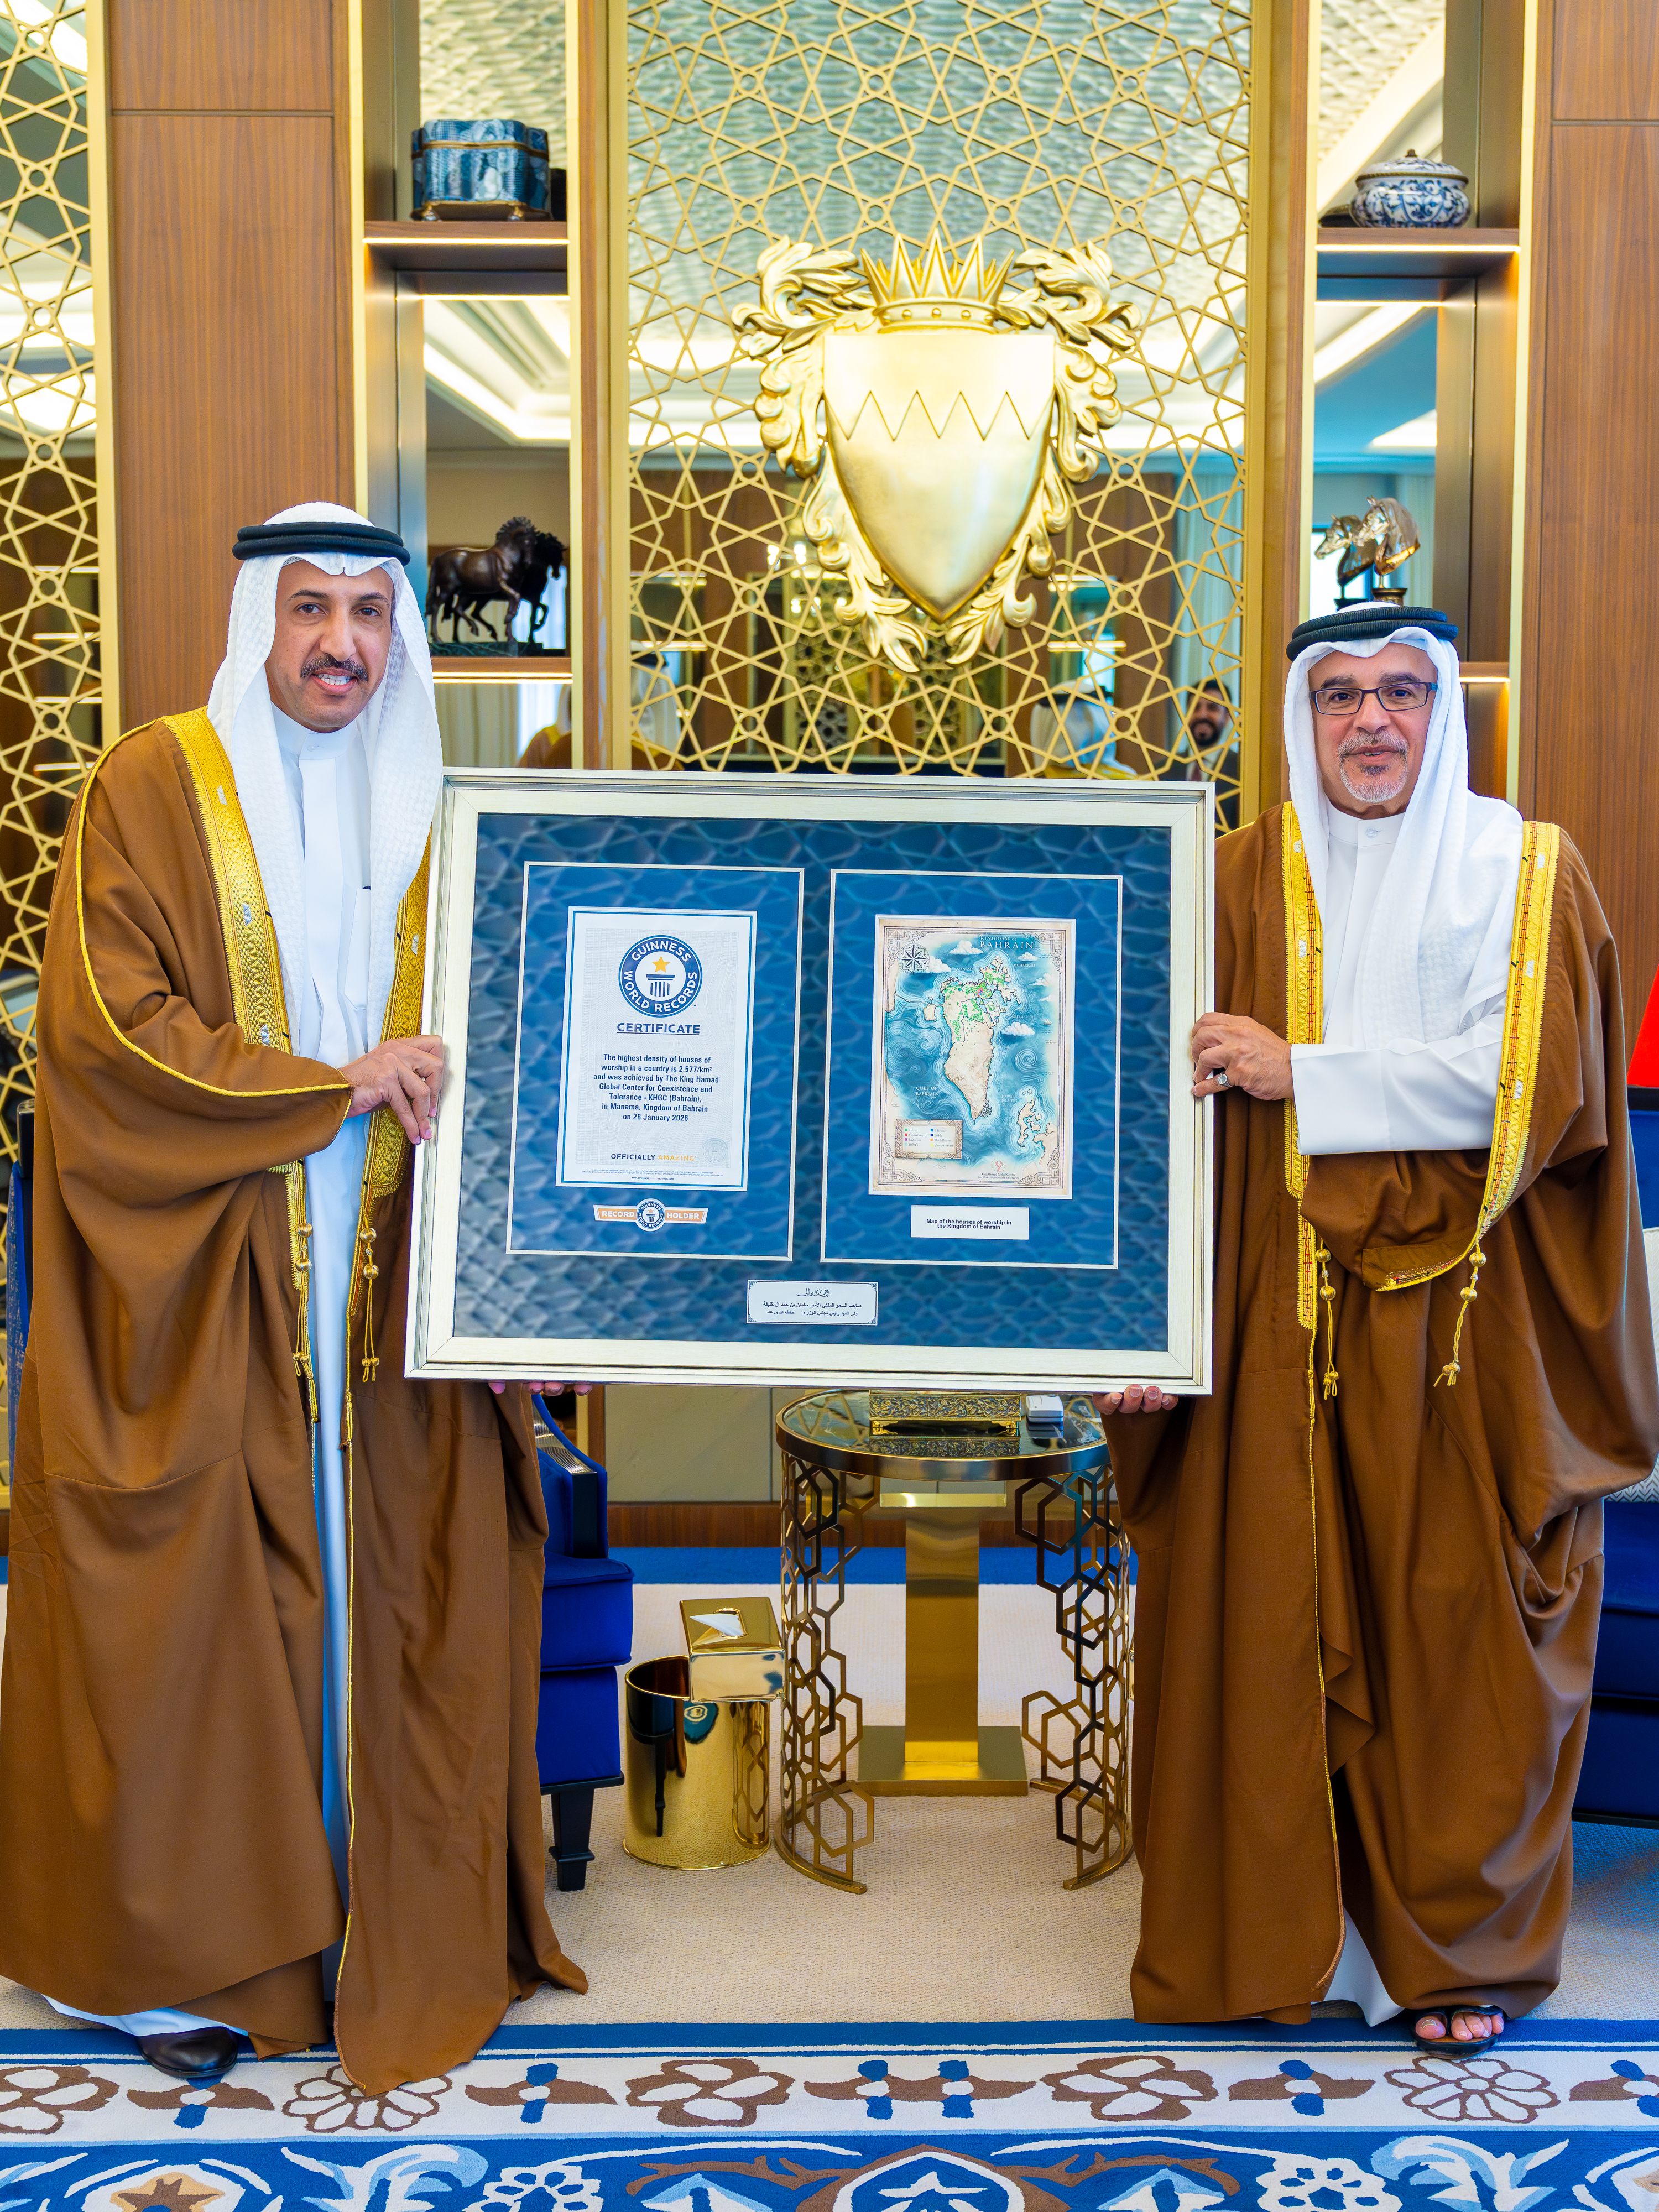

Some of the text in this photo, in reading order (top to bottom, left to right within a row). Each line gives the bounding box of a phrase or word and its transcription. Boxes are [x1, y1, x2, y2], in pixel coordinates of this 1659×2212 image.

[632, 941, 691, 962] GUINNESS
[624, 971, 697, 1013] WORLD RECORDS
[617, 1023, 700, 1034] CERTIFICATE
[680, 1076, 694, 1084] King
[670, 1094, 701, 1103] (Bahrain),
[641, 1203, 661, 1211] GUINNESS
[639, 1213, 663, 1228] WORLD RECORDS
